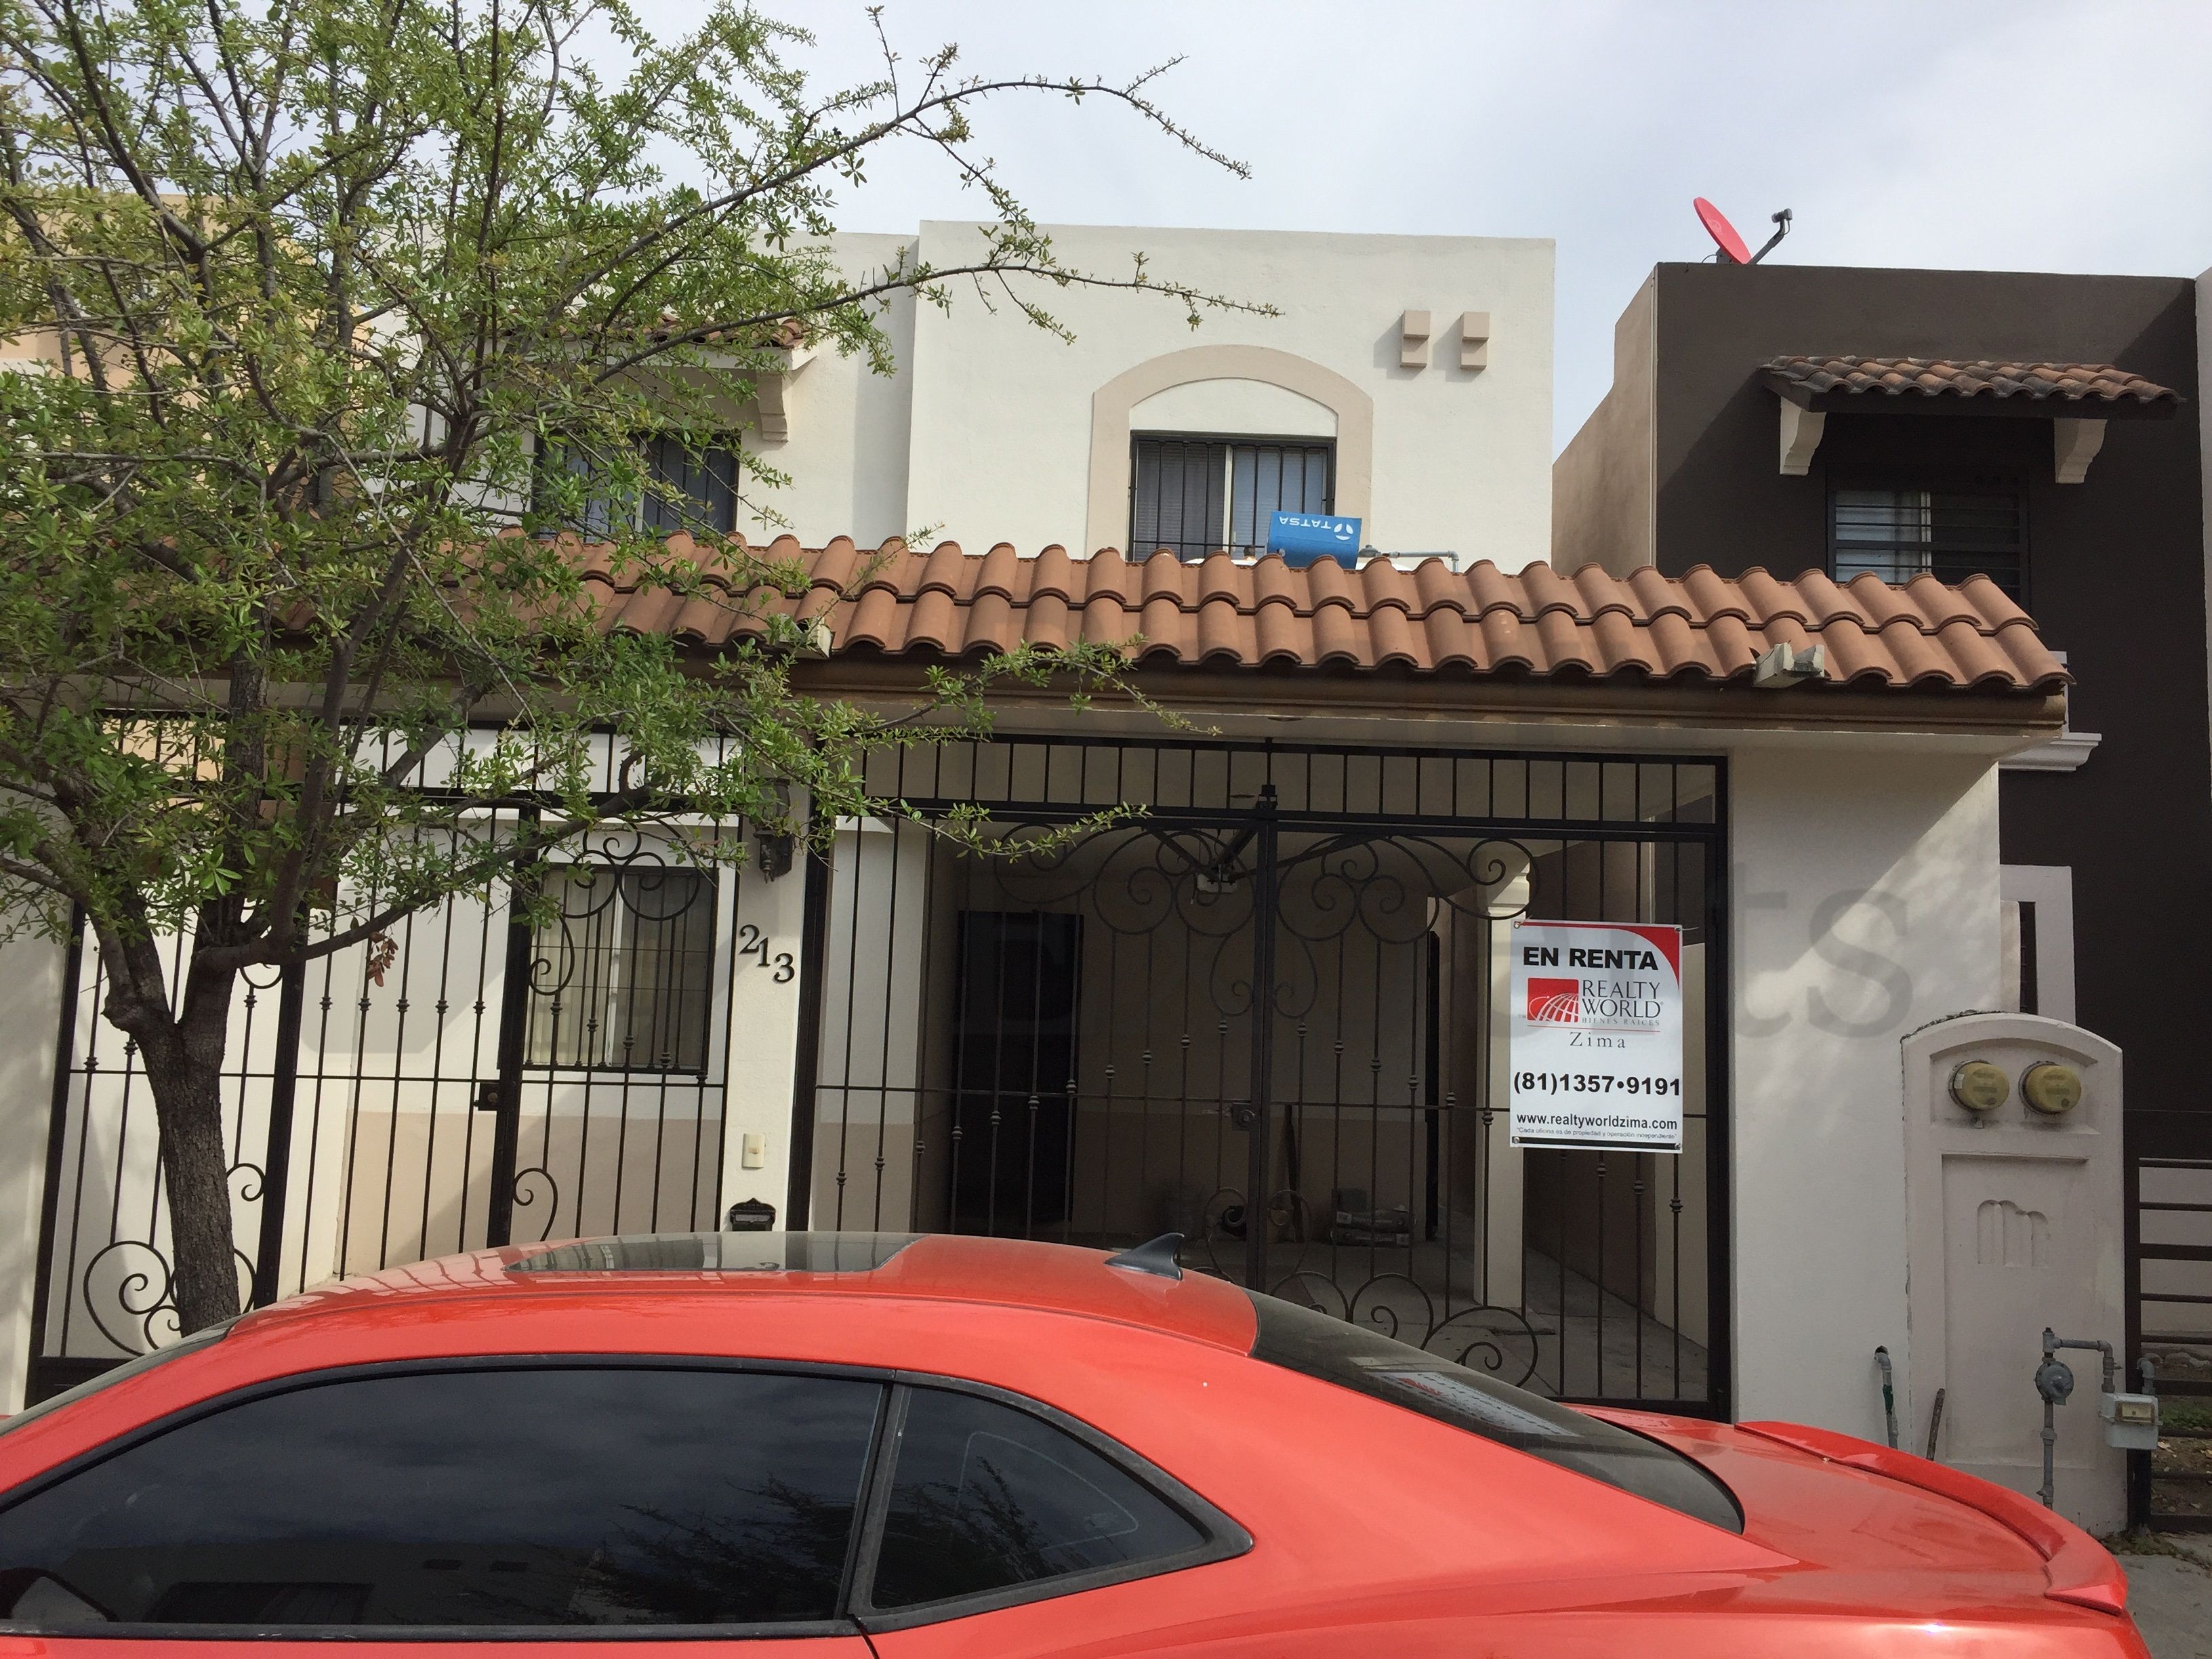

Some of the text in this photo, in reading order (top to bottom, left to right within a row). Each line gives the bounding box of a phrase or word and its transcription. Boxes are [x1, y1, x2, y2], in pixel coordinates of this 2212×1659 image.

[1279, 516, 1332, 529] TATSA
[739, 924, 795, 983] 213
[1523, 947, 1658, 970] EN RENTA
[1582, 979, 1660, 1000] REALTY
[1582, 998, 1660, 1018] WORLD
[1570, 1031, 1626, 1048] Zima
[1517, 1113, 1678, 1130] www.realtyworldzima.com
